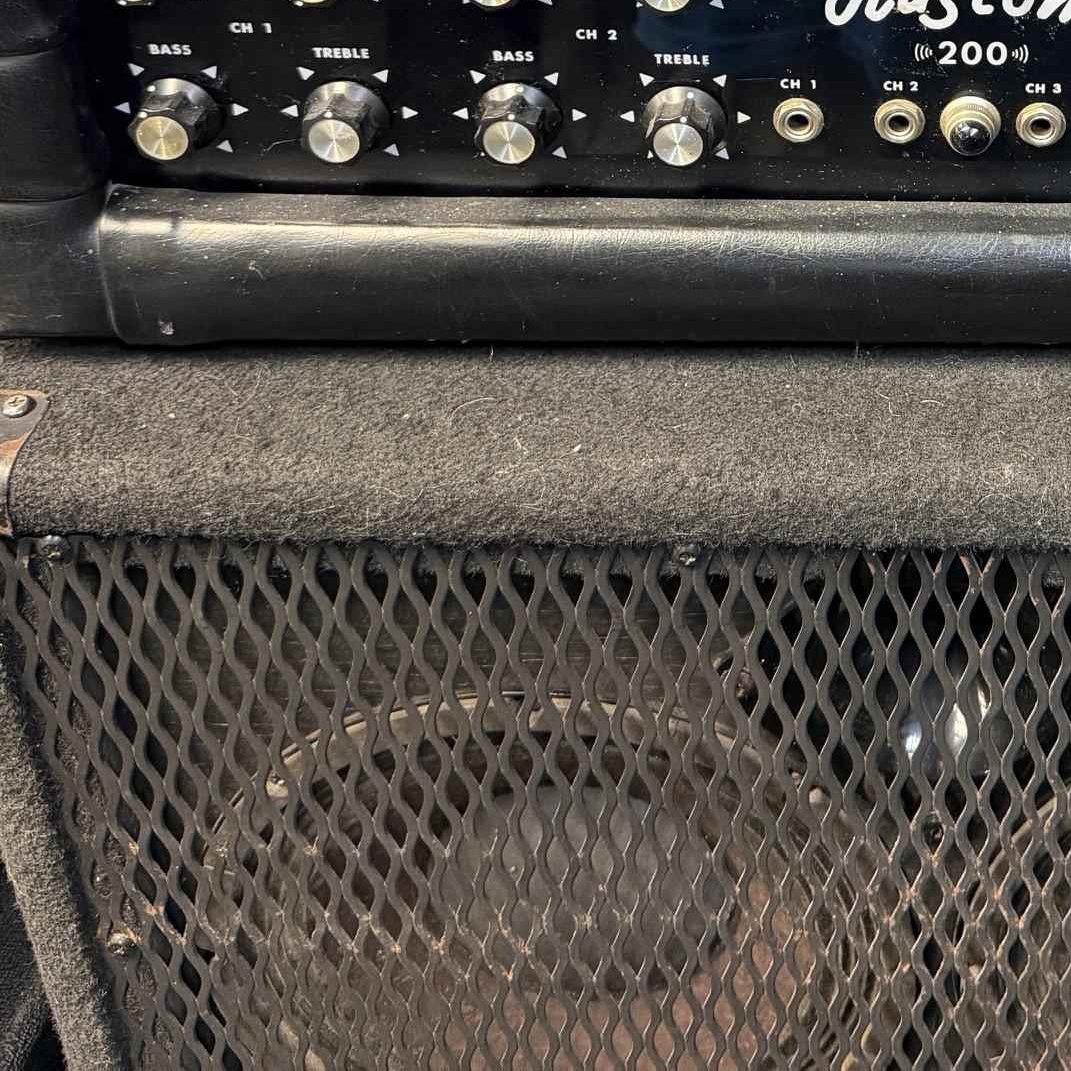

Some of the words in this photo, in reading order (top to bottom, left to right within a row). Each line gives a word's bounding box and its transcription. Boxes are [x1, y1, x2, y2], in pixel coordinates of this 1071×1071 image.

[229, 21, 254, 34] CH
[262, 22, 273, 34] 1
[575, 28, 598, 40] CH
[607, 29, 618, 41] 2
[148, 43, 192, 56] BASS
[312, 46, 370, 59] TREBLE
[492, 50, 534, 62] BASS
[938, 40, 1008, 66] 200
[654, 53, 710, 66] TREBLE
[780, 78, 801, 89] CH
[810, 79, 817, 90] 1
[883, 80, 905, 91] CH
[909, 81, 919, 92] 2
[1025, 82, 1047, 94] CH
[1051, 83, 1062, 94] 3
